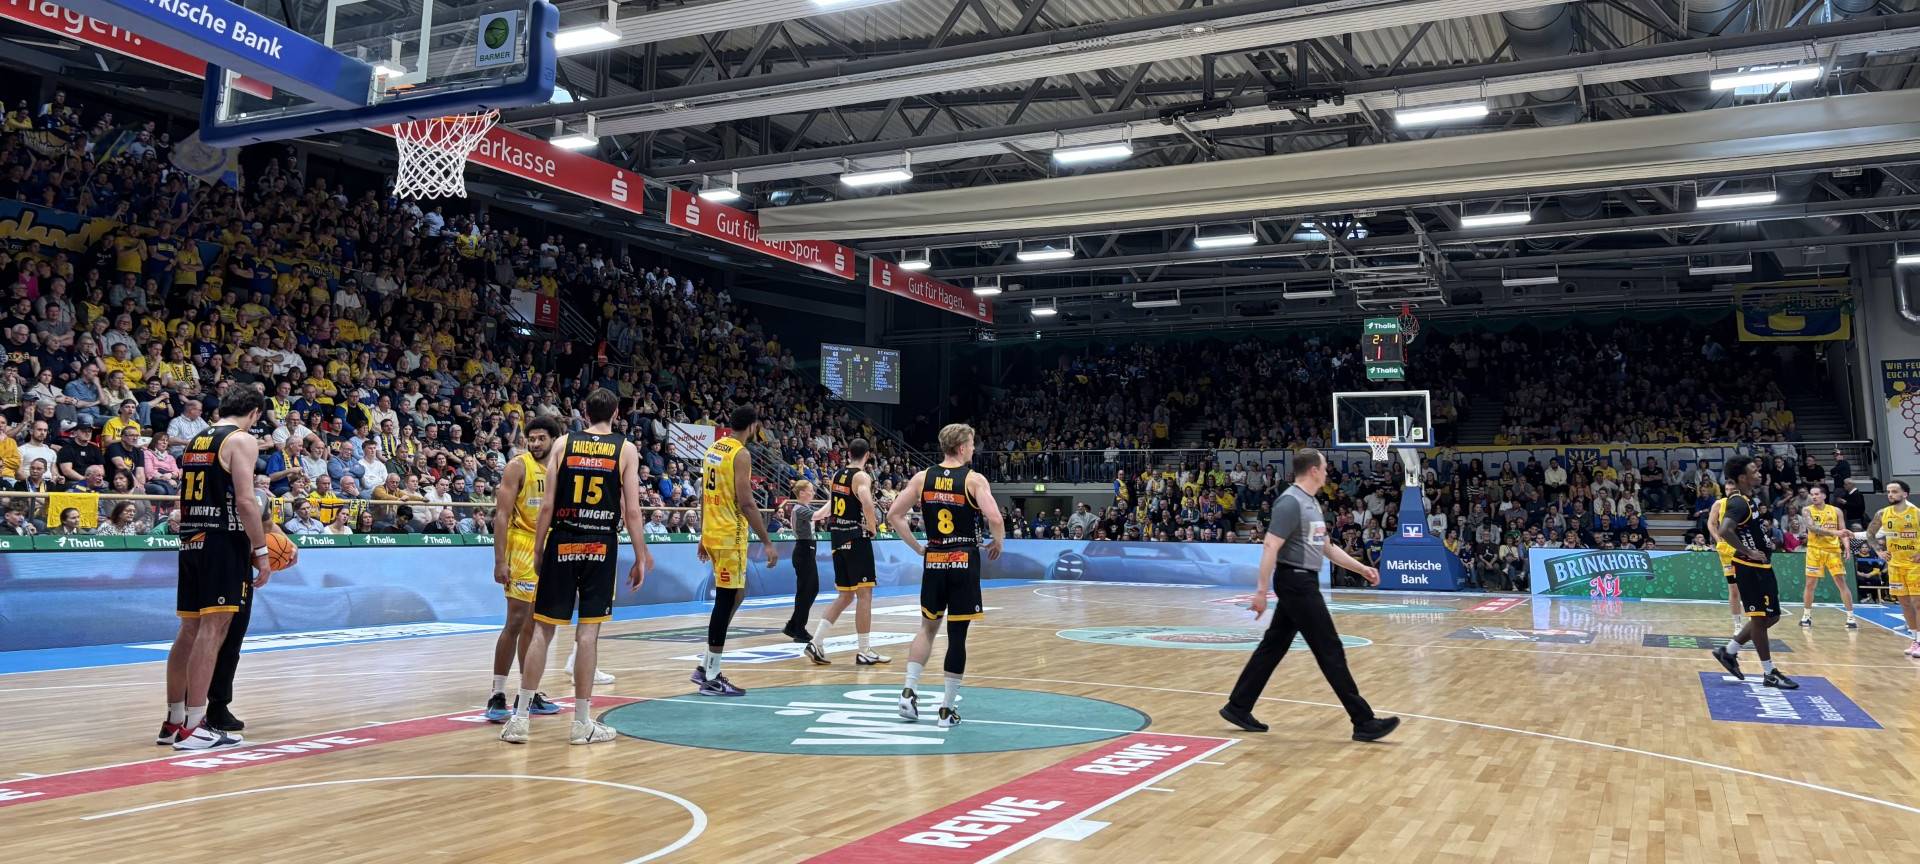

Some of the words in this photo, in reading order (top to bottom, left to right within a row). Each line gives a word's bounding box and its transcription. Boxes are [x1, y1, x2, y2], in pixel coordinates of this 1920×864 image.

[232, 21, 284, 60] Bank
[479, 51, 511, 62] BARMER
[716, 212, 740, 238] Gut
[789, 240, 822, 263] Sport.
[908, 277, 924, 296] Gut
[925, 282, 937, 300] für
[938, 287, 965, 310] Hagen.
[1885, 362, 1902, 370] WIR
[184, 470, 205, 501] 13
[706, 466, 716, 491] 19
[573, 474, 604, 505] 15
[579, 508, 615, 520] KNIGHTS
[833, 496, 846, 517] 19
[937, 508, 955, 535] 8
[1887, 520, 1893, 529] 0
[68, 537, 105, 548] Thalia
[155, 537, 181, 547] Thal
[307, 536, 335, 545] Thalia
[372, 535, 396, 544] Thalia
[430, 535, 452, 544] Thalia
[1386, 559, 1442, 571] Märkische
[1401, 573, 1429, 584] Bank
[168, 735, 377, 769] REWE
[1072, 742, 1188, 776] REWE
[898, 796, 1067, 849] REWE
